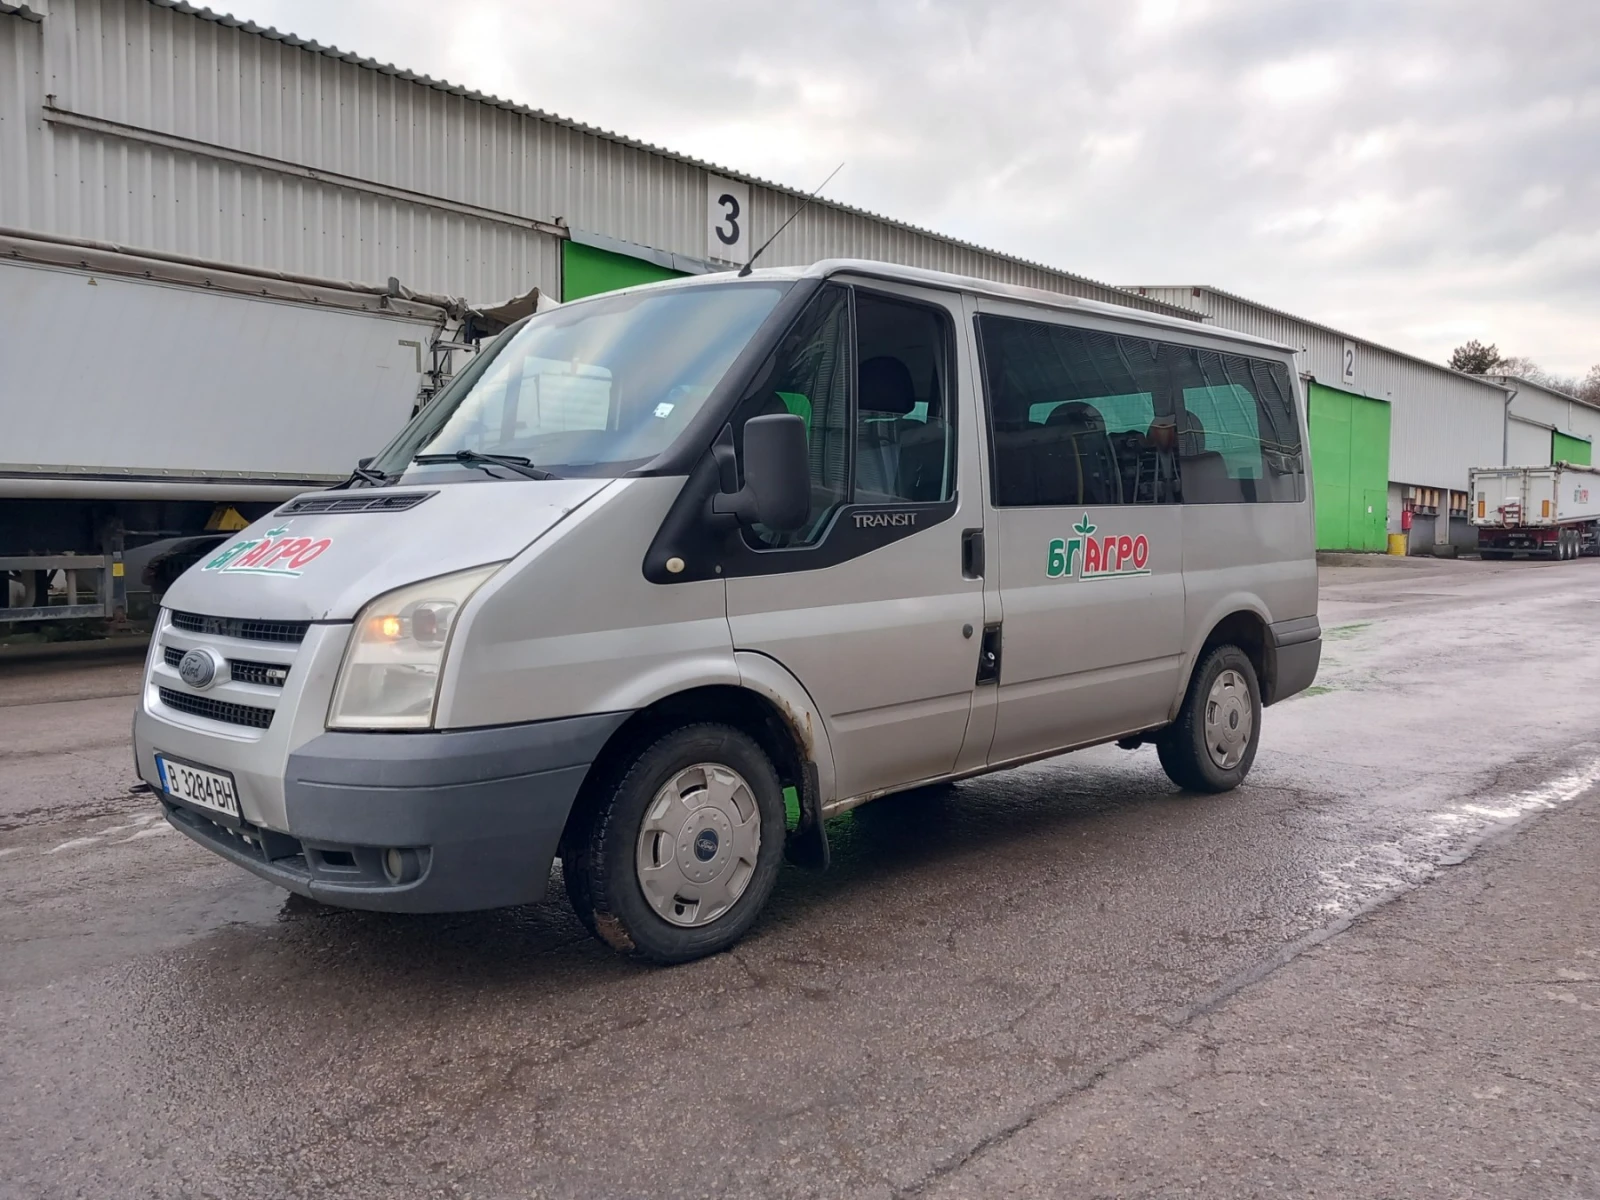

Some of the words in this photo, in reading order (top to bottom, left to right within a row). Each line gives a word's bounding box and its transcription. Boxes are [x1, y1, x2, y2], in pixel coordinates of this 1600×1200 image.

[715, 194, 740, 245] 3
[1345, 349, 1353, 377] 2
[853, 513, 917, 528] TRANSIT
[182, 656, 201, 678] Ford
